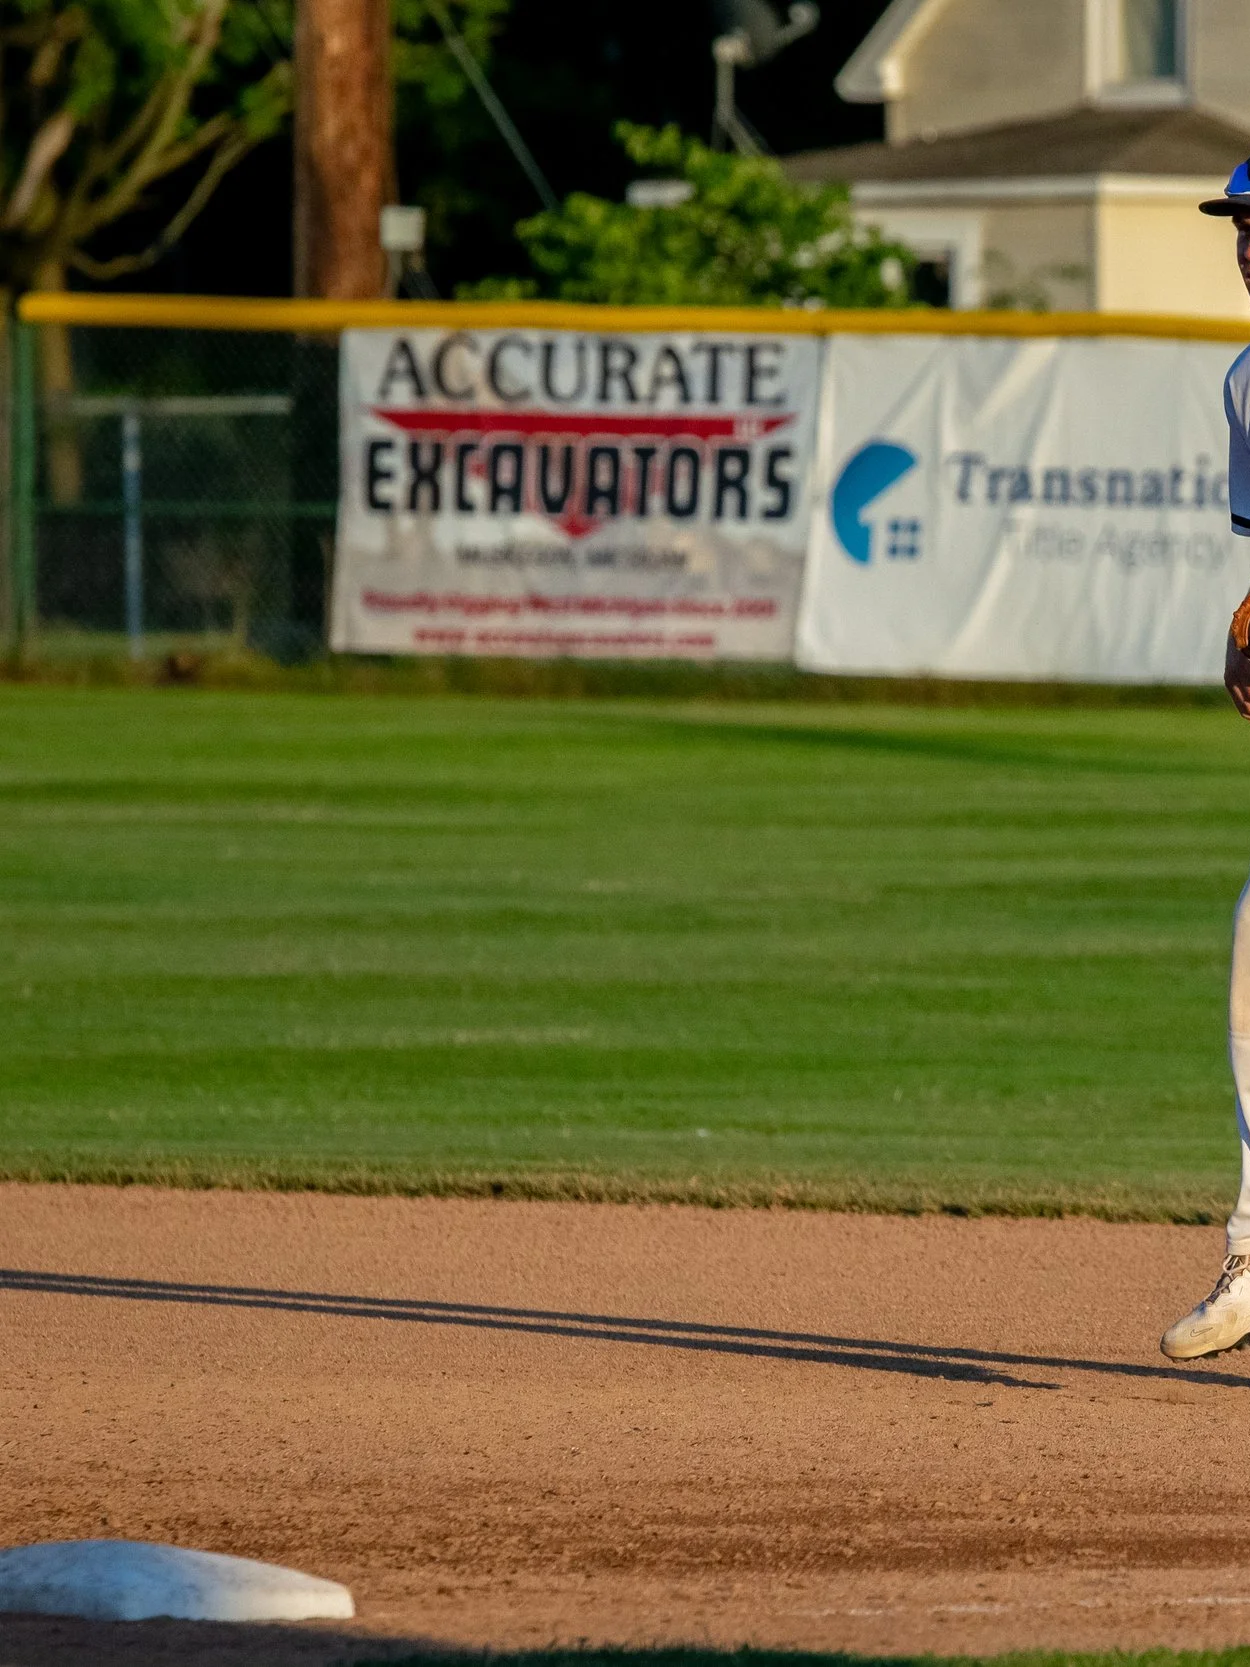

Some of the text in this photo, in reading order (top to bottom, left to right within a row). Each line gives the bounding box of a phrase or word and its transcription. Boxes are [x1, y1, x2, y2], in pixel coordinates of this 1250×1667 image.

[378, 333, 788, 406] ACCURATE
[367, 439, 792, 520] EXCAVATORS
[943, 450, 1230, 508] Transnatio
